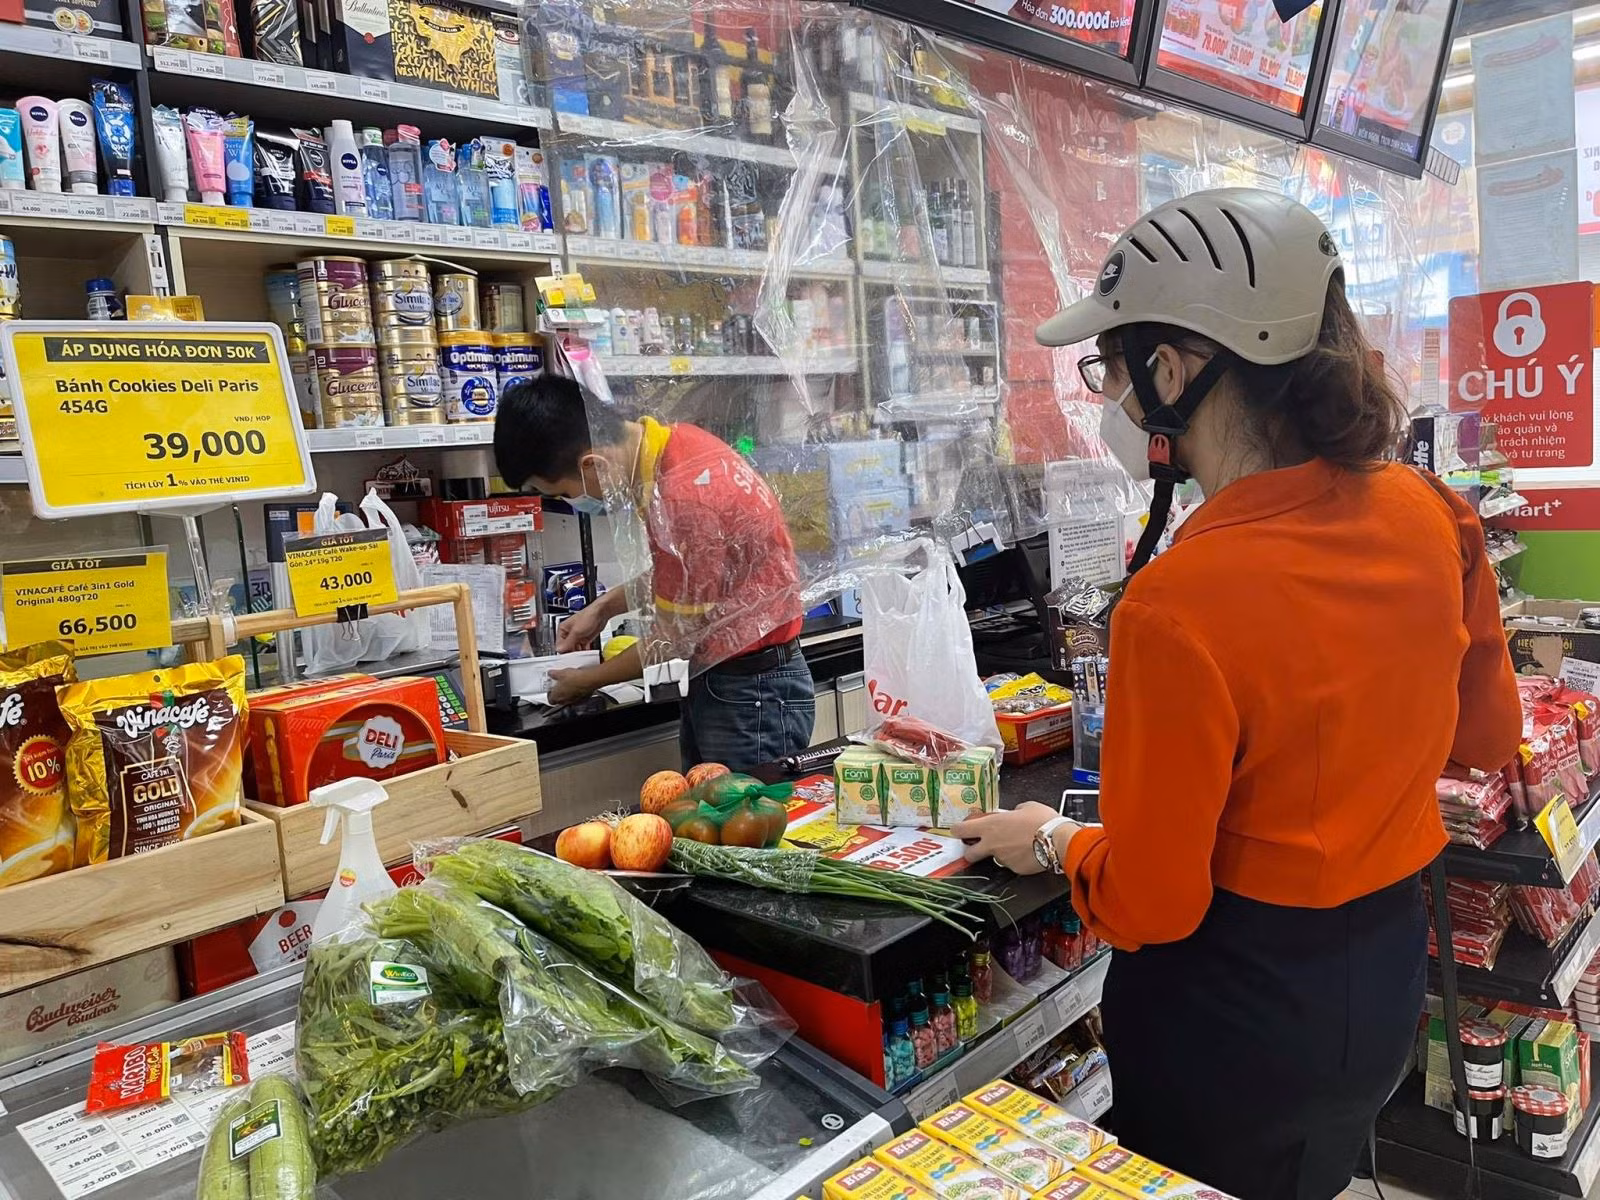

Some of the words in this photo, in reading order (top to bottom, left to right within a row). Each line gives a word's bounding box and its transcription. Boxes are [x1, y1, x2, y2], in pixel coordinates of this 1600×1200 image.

[1021, 1, 1035, 14] Hóa
[1035, 7, 1048, 21] đơn
[1049, 5, 1111, 29] 300.000đ
[61, 340, 84, 356] ÁP
[90, 343, 140, 360] DỤNG
[145, 341, 181, 358] HÓA
[184, 345, 222, 358] ĐƠN
[226, 346, 256, 359] 50K
[56, 378, 103, 393] Bánh
[108, 379, 177, 393] Cookies
[182, 379, 213, 392] Deli
[219, 379, 259, 392] Paris
[1458, 357, 1543, 402] CHÚ
[1557, 354, 1584, 394] Ý
[59, 400, 108, 414] 454G
[1493, 412, 1525, 424] khách
[1529, 412, 1546, 421] vui
[1549, 410, 1574, 422] lòng
[1515, 423, 1541, 436] quản
[1545, 423, 1557, 433] và
[143, 430, 266, 463] 39,000
[1500, 435, 1528, 447] trách
[1532, 434, 1566, 447] nhiệm
[1521, 448, 1533, 458] tư
[1536, 448, 1565, 460] trang
[124, 481, 146, 489] TÍCH
[190, 477, 207, 486] VÀO
[225, 475, 250, 483] VINID
[321, 537, 338, 546] GIÁ
[340, 535, 354, 544] TỐT
[323, 547, 339, 556] Café
[339, 544, 368, 554] Wake-up
[51, 560, 75, 571] GIÁ
[77, 559, 102, 568] TỐT
[289, 560, 303, 568] Gòn
[331, 555, 343, 563] T20
[15, 585, 65, 597] VINACAFÉ
[67, 583, 89, 593] Café
[91, 582, 111, 591] 3in1
[113, 580, 135, 589] Gold
[320, 571, 373, 591] 43,000
[16, 595, 55, 608] Original
[57, 593, 98, 604] 480gT20
[59, 614, 137, 636] 66,500
[116, 697, 210, 739] Vinacafé
[365, 729, 398, 749] DELI
[370, 748, 396, 760] Paris
[28, 756, 61, 782] 10%
[133, 778, 180, 804] GOLD
[143, 800, 179, 812] ORIGINAL
[157, 815, 180, 827] ROBUSTA
[157, 823, 180, 834] ARABICA
[278, 924, 313, 954] BEER
[27, 986, 121, 1034] Budweiser
[67, 1001, 120, 1028] Budvar
[120, 1046, 147, 1099] HARIBO
[54, 1134, 89, 1151] 29.000
[82, 1171, 118, 1190] 23.000
